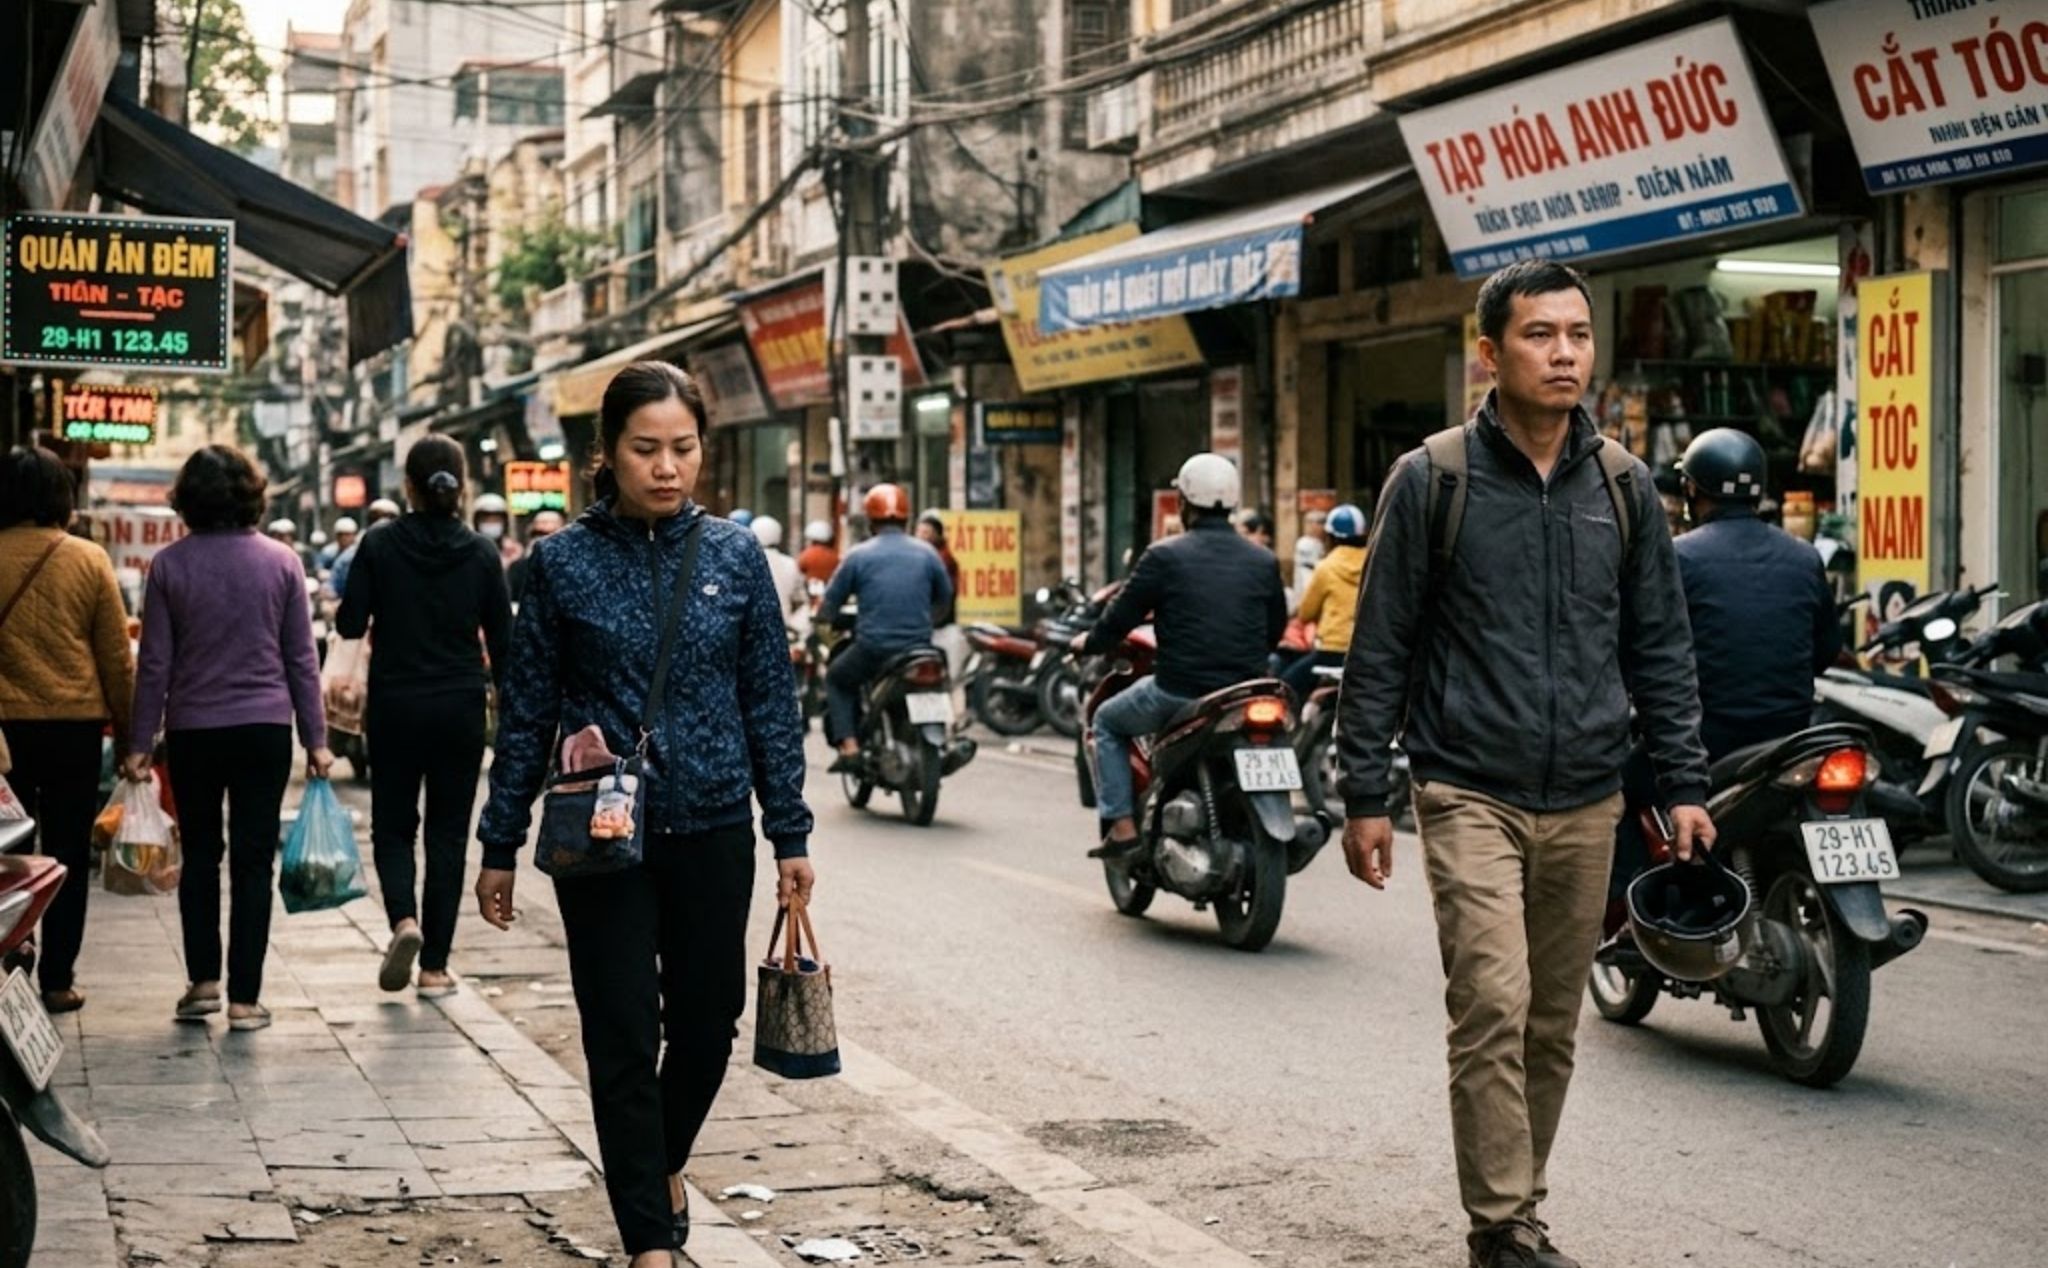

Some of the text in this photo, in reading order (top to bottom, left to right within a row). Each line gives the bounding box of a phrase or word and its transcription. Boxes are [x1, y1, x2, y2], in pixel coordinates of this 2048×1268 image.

[1854, 16, 2048, 122] CẮT TÓC
[1425, 56, 1738, 204] TẠP HÓA ANH ĐỨC
[19, 231, 98, 273] QUÁN
[137, 285, 184, 310] TẠC
[112, 329, 189, 354] 123.45
[1869, 286, 1920, 379] CẮT
[1869, 390, 1918, 470] TÓC
[1863, 496, 1923, 560] NAM
[1816, 824, 1877, 850] 29-H1
